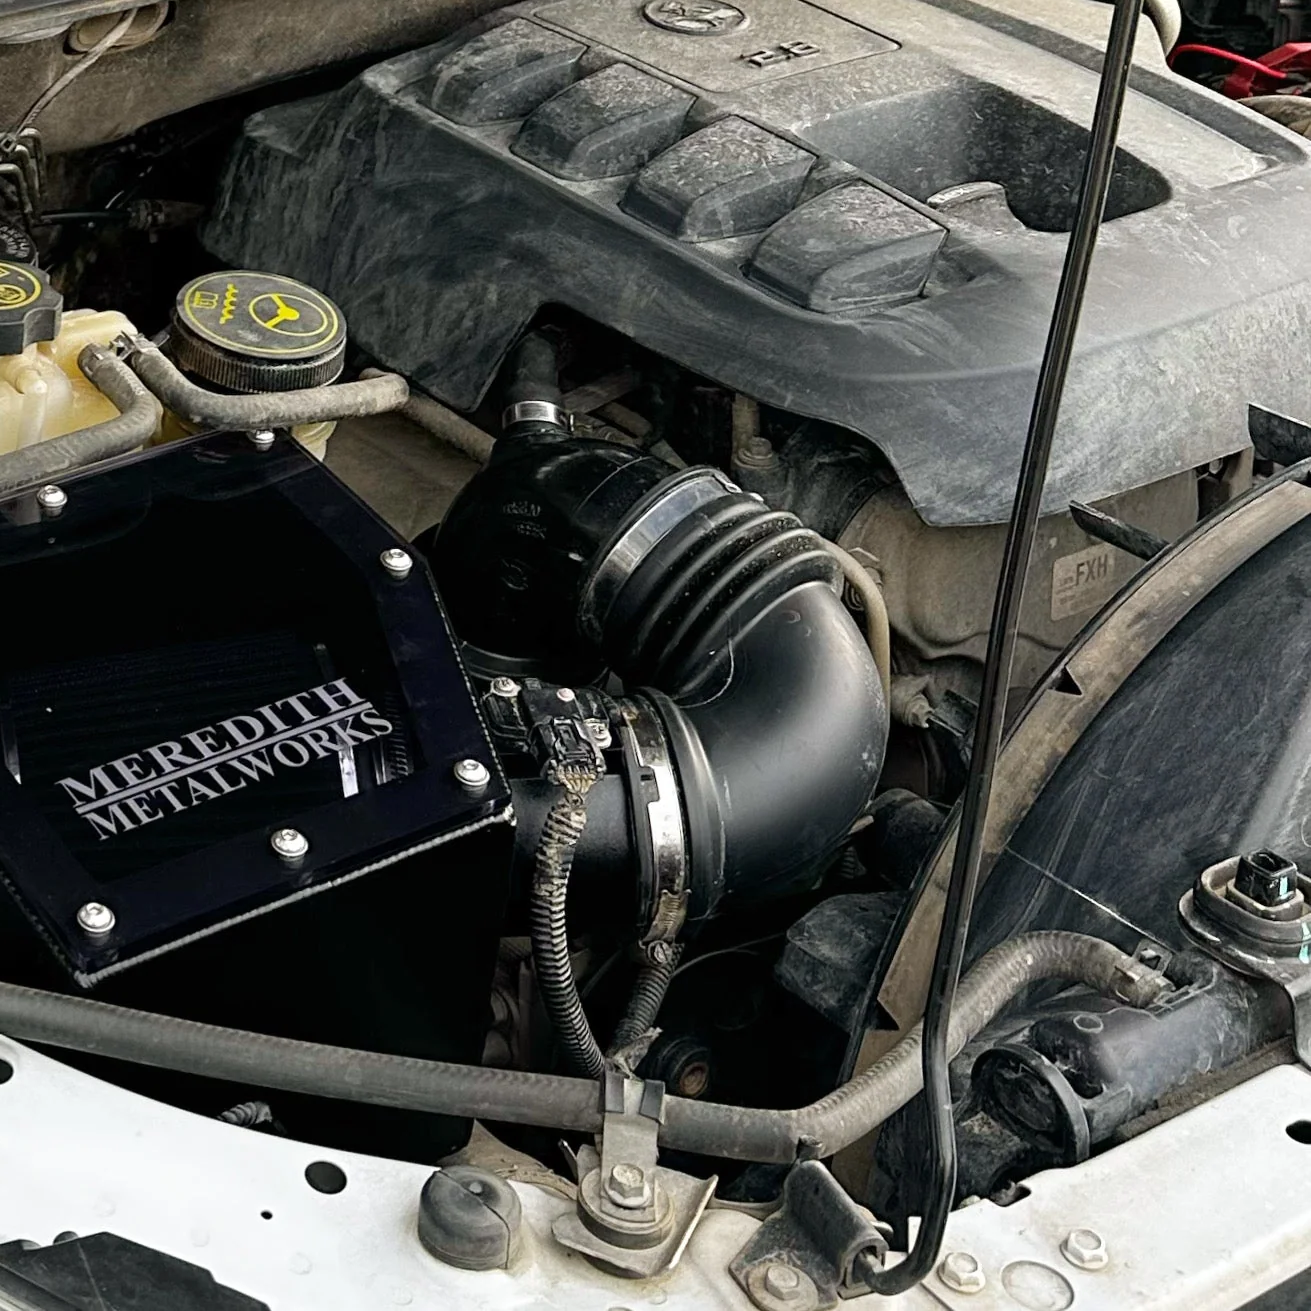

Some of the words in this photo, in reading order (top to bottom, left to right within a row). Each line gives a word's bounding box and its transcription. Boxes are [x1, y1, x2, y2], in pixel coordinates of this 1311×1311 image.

[1076, 554, 1108, 586] FXH
[54, 677, 367, 807] MEREDITH
[81, 708, 393, 841] METALWORKS
